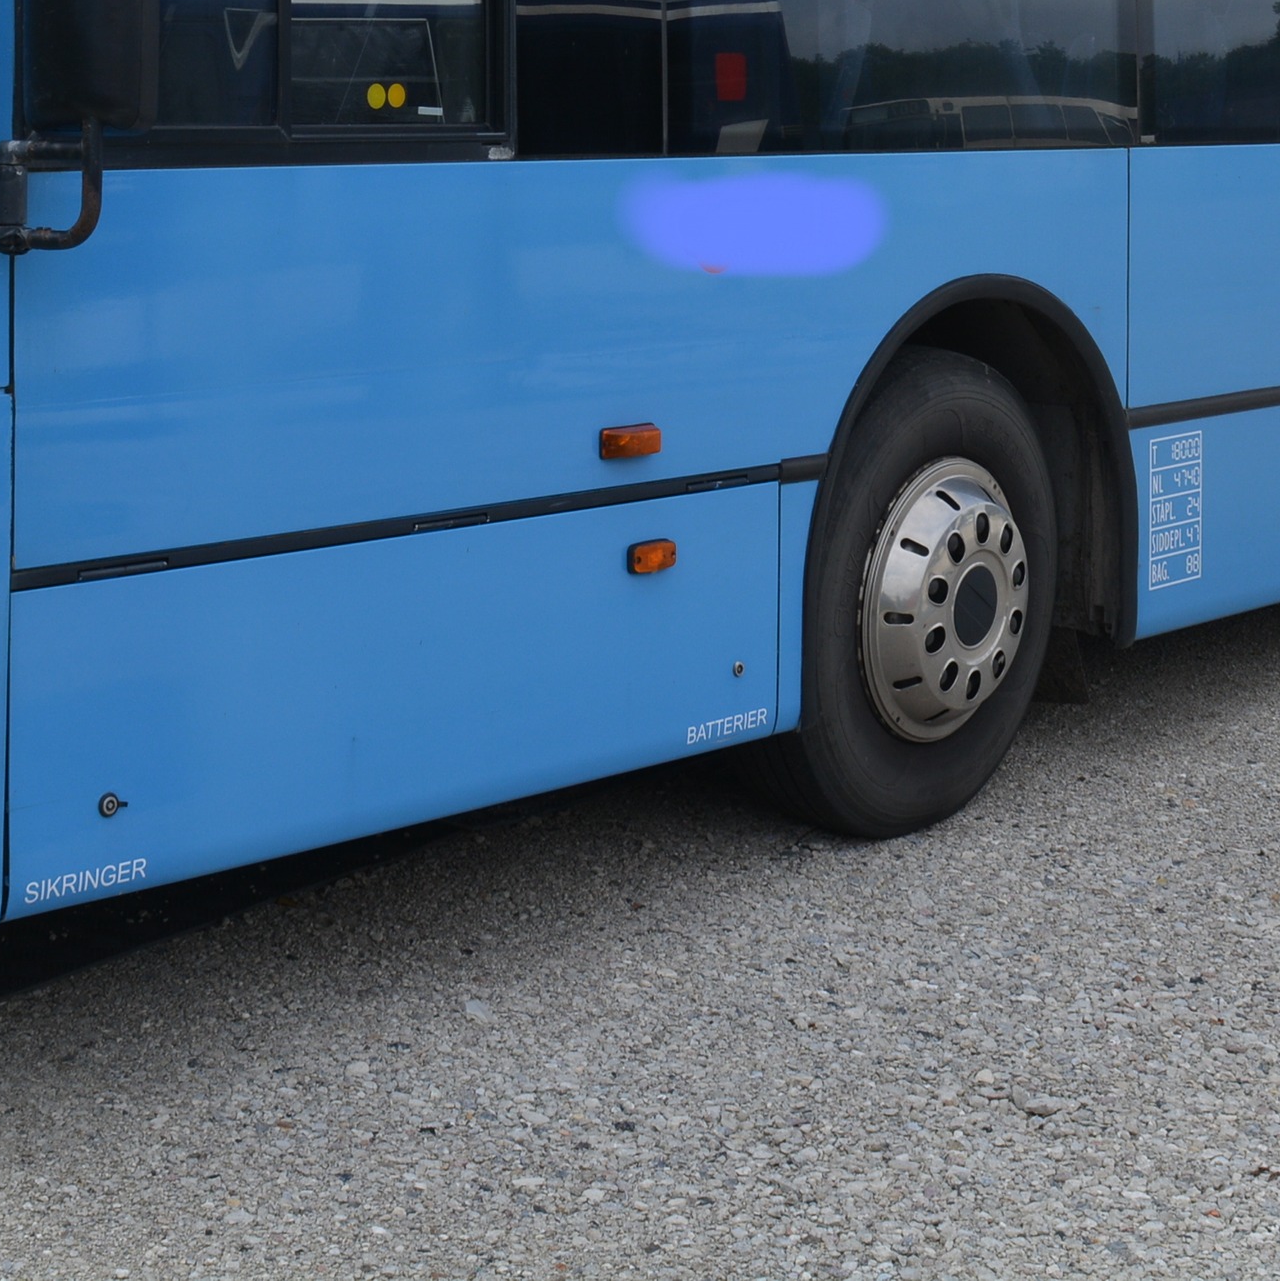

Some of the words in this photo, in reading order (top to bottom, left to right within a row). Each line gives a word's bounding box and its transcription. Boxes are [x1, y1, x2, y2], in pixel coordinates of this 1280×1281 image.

[1152, 445, 1158, 466] T
[1152, 474, 1164, 495] NL
[1151, 528, 1186, 555] SIDDEPL.
[1151, 560, 1170, 584] BAG.
[686, 707, 768, 745] BATTERIER
[24, 858, 147, 904] SIKRINGER
